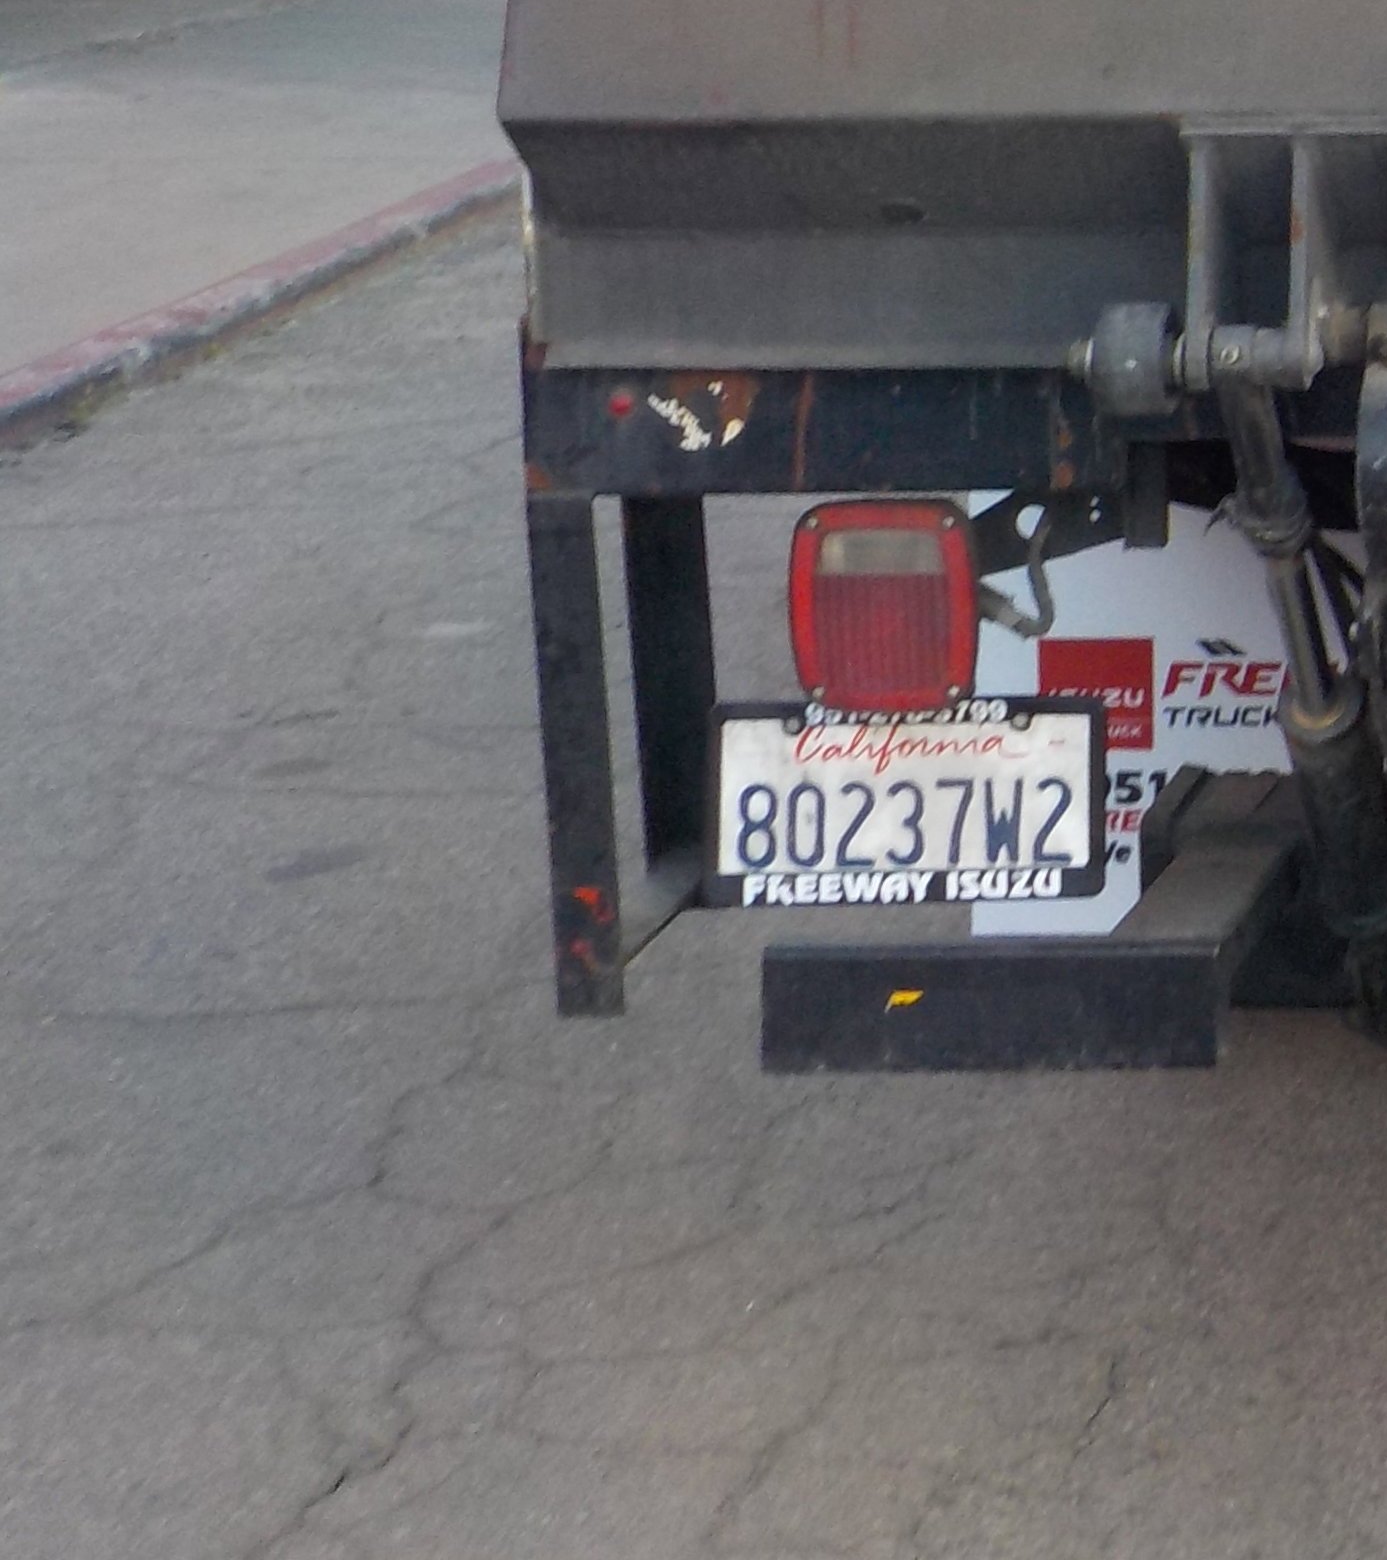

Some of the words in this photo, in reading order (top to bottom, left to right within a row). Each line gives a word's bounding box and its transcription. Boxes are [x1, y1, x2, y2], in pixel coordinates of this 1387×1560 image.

[794, 721, 1028, 775] California
[737, 777, 1074, 869] 80237W2
[743, 868, 934, 908] FREEWAY
[944, 866, 1063, 900] ISUZU
